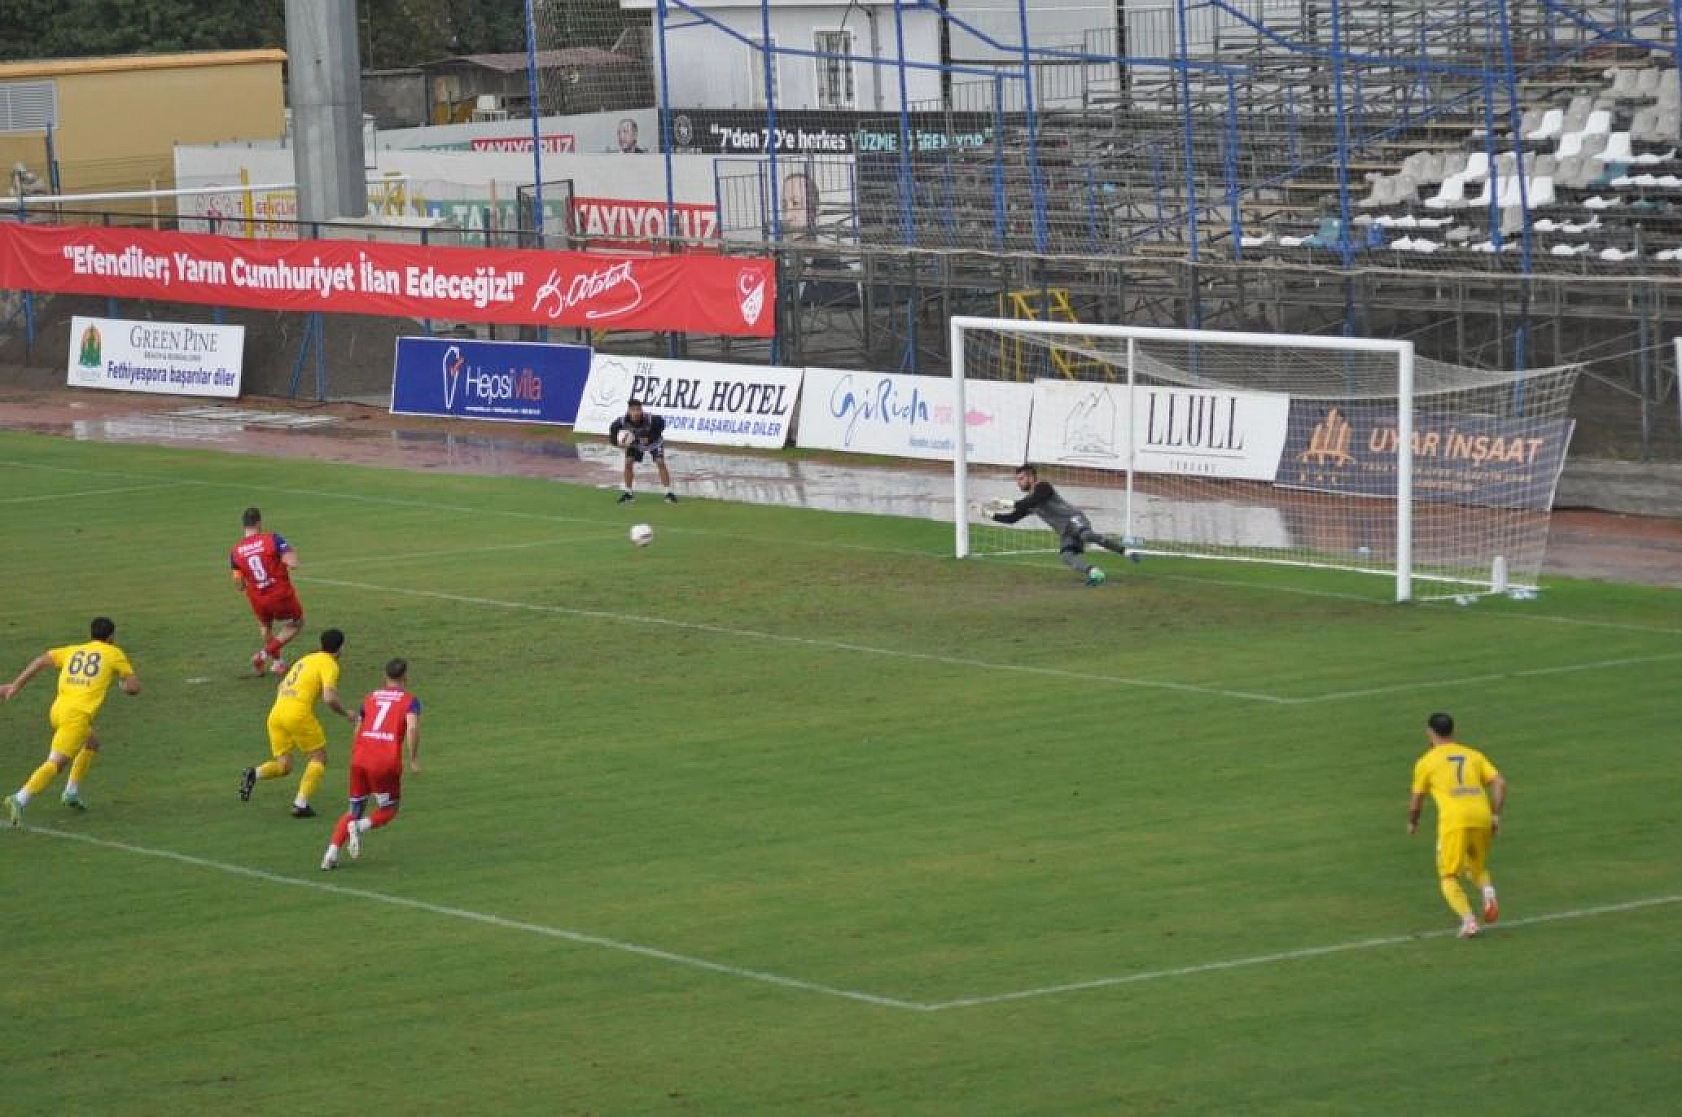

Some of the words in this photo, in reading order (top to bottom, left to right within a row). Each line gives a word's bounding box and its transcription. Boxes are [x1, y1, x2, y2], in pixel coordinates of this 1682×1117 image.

[174, 251, 226, 286] Yarın
[231, 255, 356, 298] Cumhuriyet
[360, 251, 400, 296] İlan
[130, 325, 182, 350] GREEN
[183, 328, 220, 352] PINE
[106, 360, 167, 384] Fethiyespora
[628, 374, 702, 410] PEARL
[708, 380, 789, 416] HOTEL
[1145, 392, 1244, 450] LLULL
[1445, 427, 1544, 467] İNŞAAT
[69, 650, 102, 677] 68
[372, 701, 393, 731] 7
[1446, 755, 1466, 785] 7
